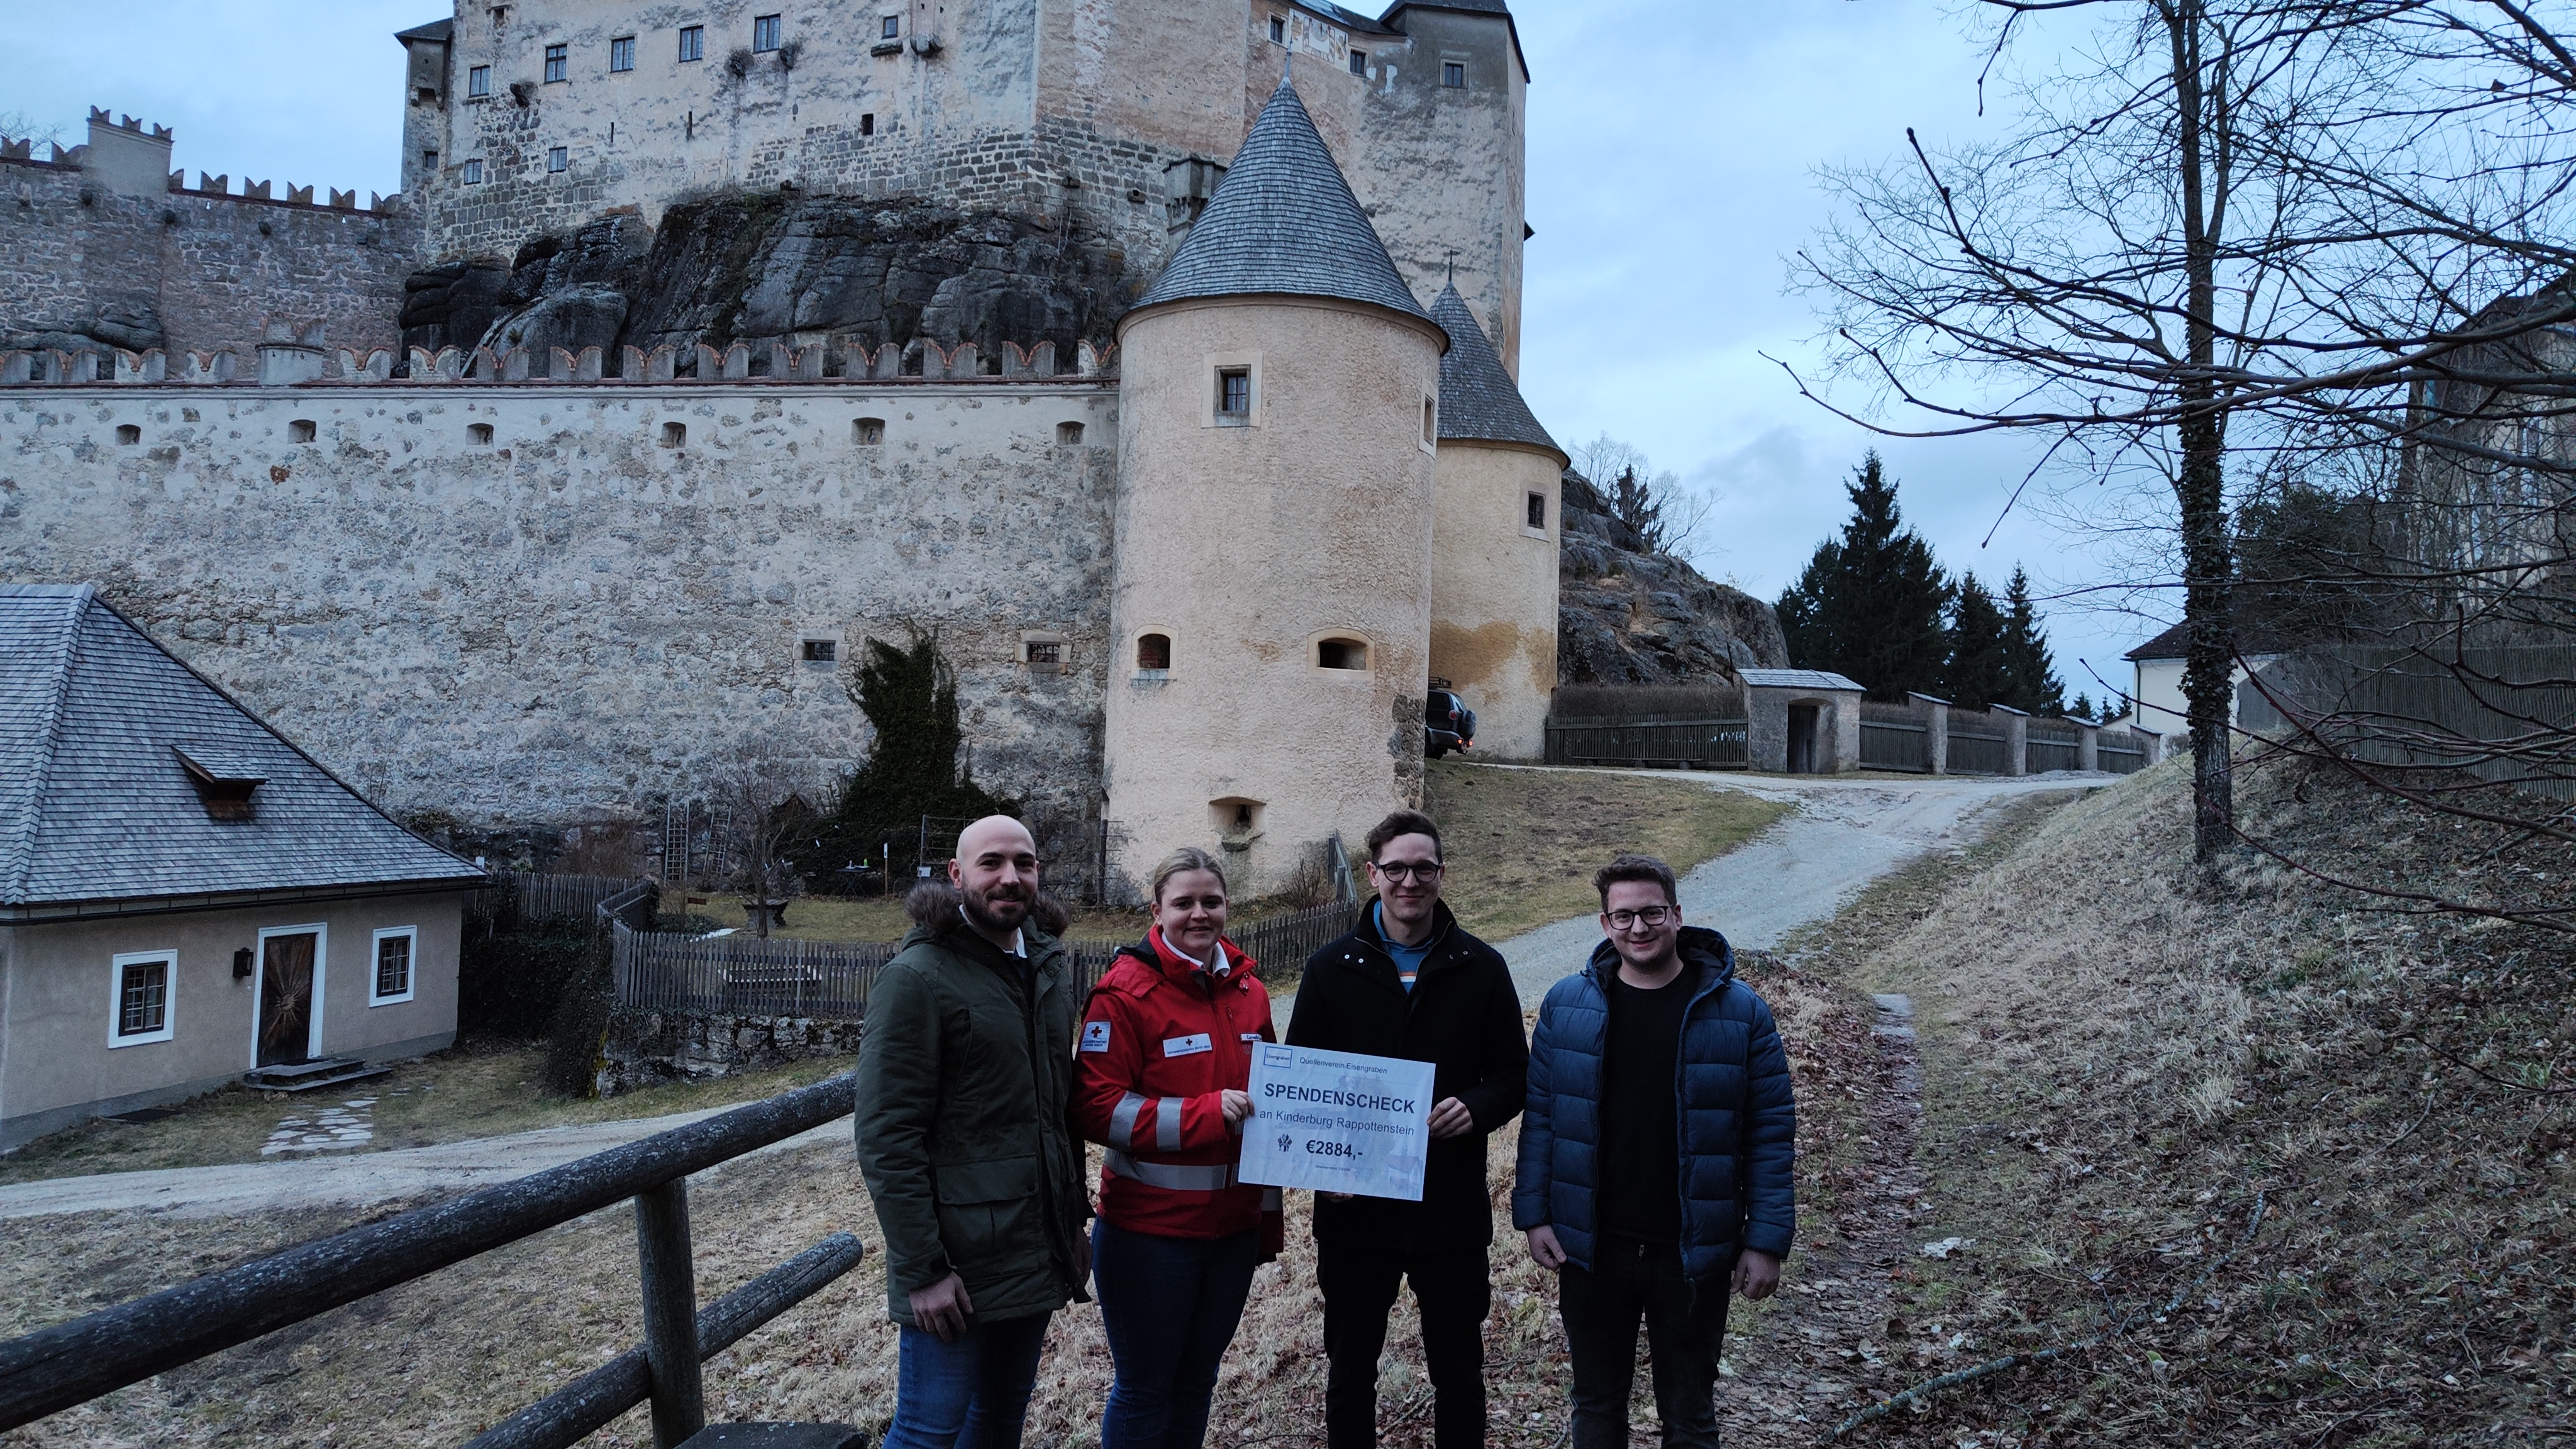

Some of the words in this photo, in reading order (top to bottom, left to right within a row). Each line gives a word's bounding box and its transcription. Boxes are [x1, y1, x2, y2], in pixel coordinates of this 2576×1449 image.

[1299, 1057, 1345, 1069] Quellenverein
[1346, 1062, 1387, 1074] Eisengraben
[1264, 1083, 1415, 1114] SPENDENSCHECK
[1259, 1111, 1272, 1119] an
[1276, 1111, 1333, 1128] Kinderburg
[1337, 1117, 1414, 1136] Rappottenstein
[1306, 1140, 1363, 1161] €2884,-
